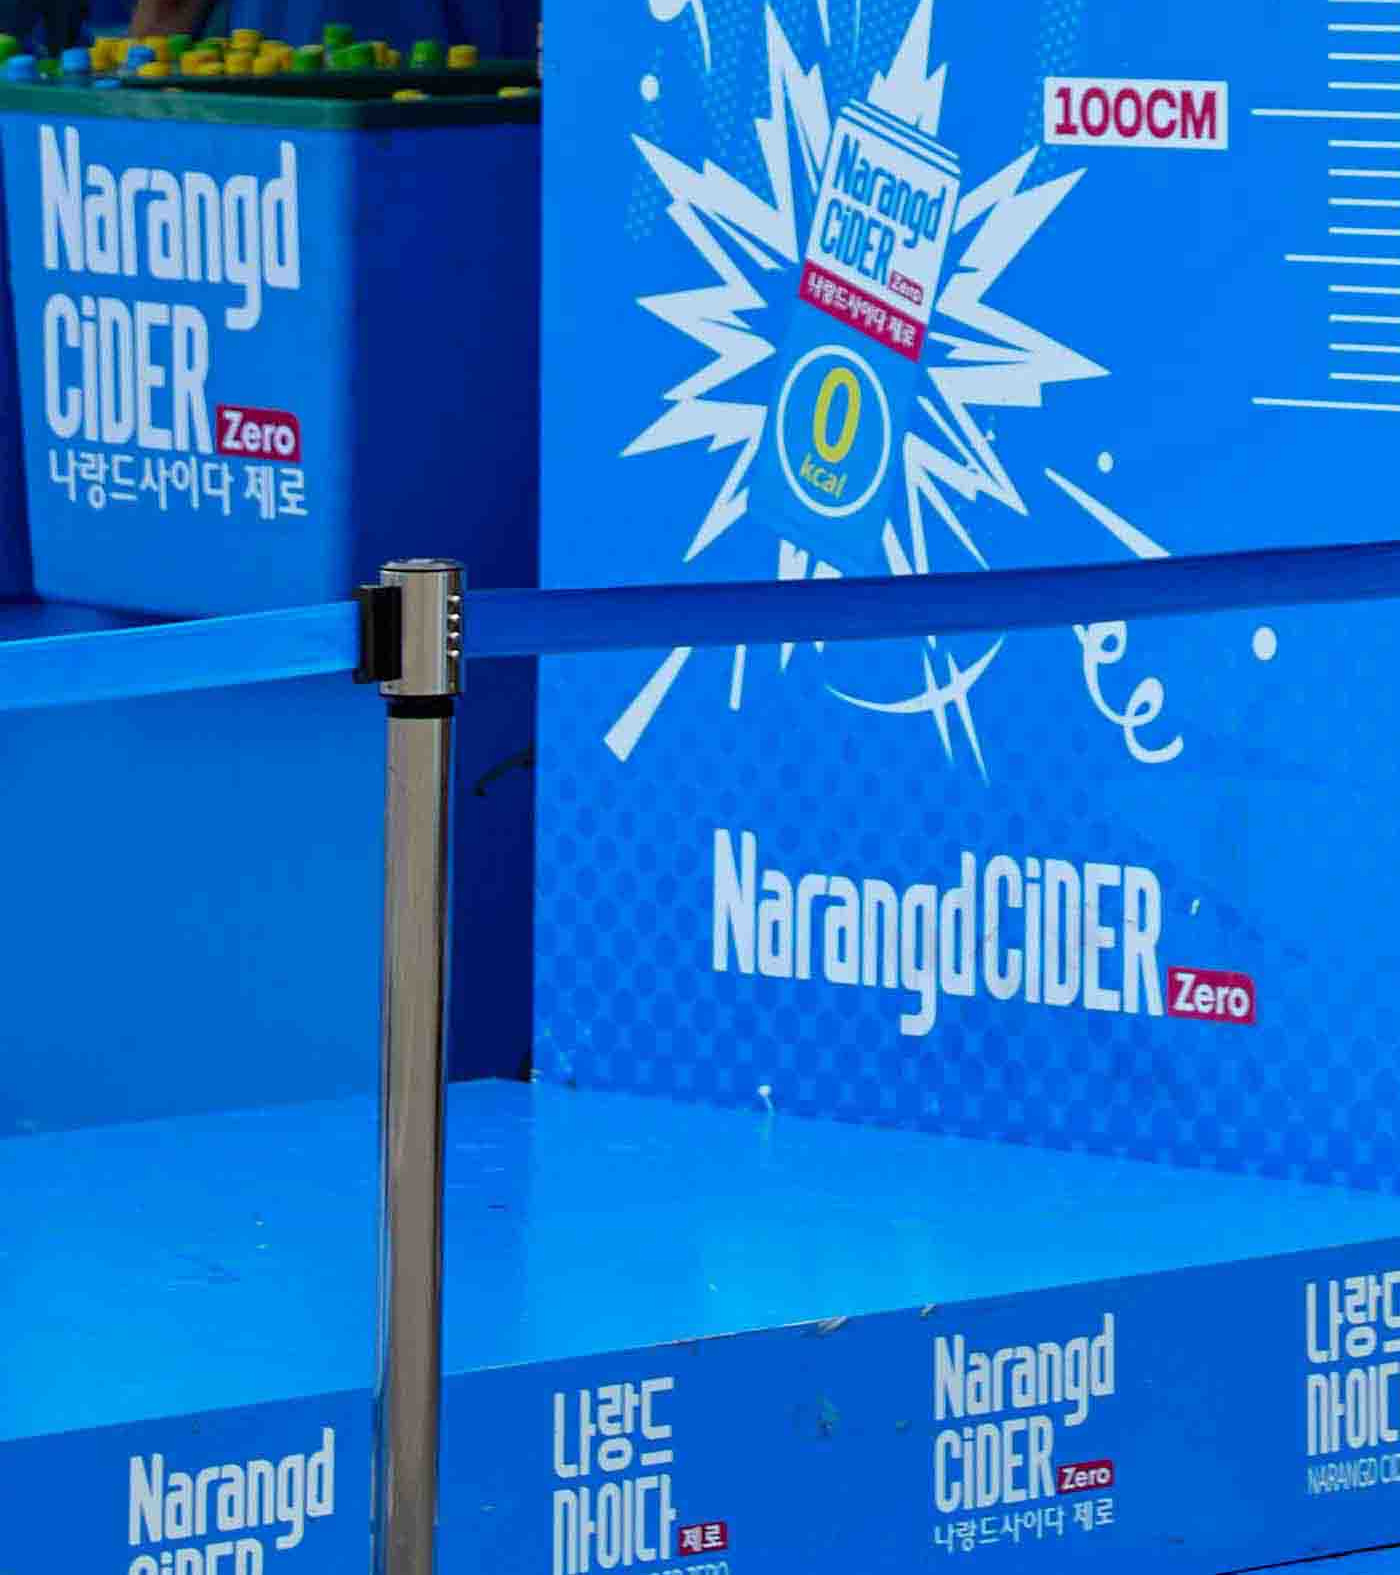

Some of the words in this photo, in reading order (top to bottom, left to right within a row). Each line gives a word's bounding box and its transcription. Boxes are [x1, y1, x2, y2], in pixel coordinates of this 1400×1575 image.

[1055, 86, 1217, 141] 100CM
[39, 124, 300, 331] Narangd
[833, 134, 946, 249] Narangd
[44, 292, 213, 456] CiDER
[221, 409, 297, 457] Zero
[813, 367, 861, 464] 0
[48, 446, 235, 516] 나랑드사이다
[243, 463, 308, 519] 제로
[800, 454, 849, 499] kcal
[1173, 973, 1250, 1020] Zero
[934, 1312, 1115, 1427] Narangd
[128, 1427, 335, 1550] Narangd
[934, 1415, 1055, 1513] CiDER
[1060, 1462, 1111, 1492] Zero
[934, 1507, 1065, 1553] 나랑드사이다
[1073, 1498, 1114, 1529] 제로
